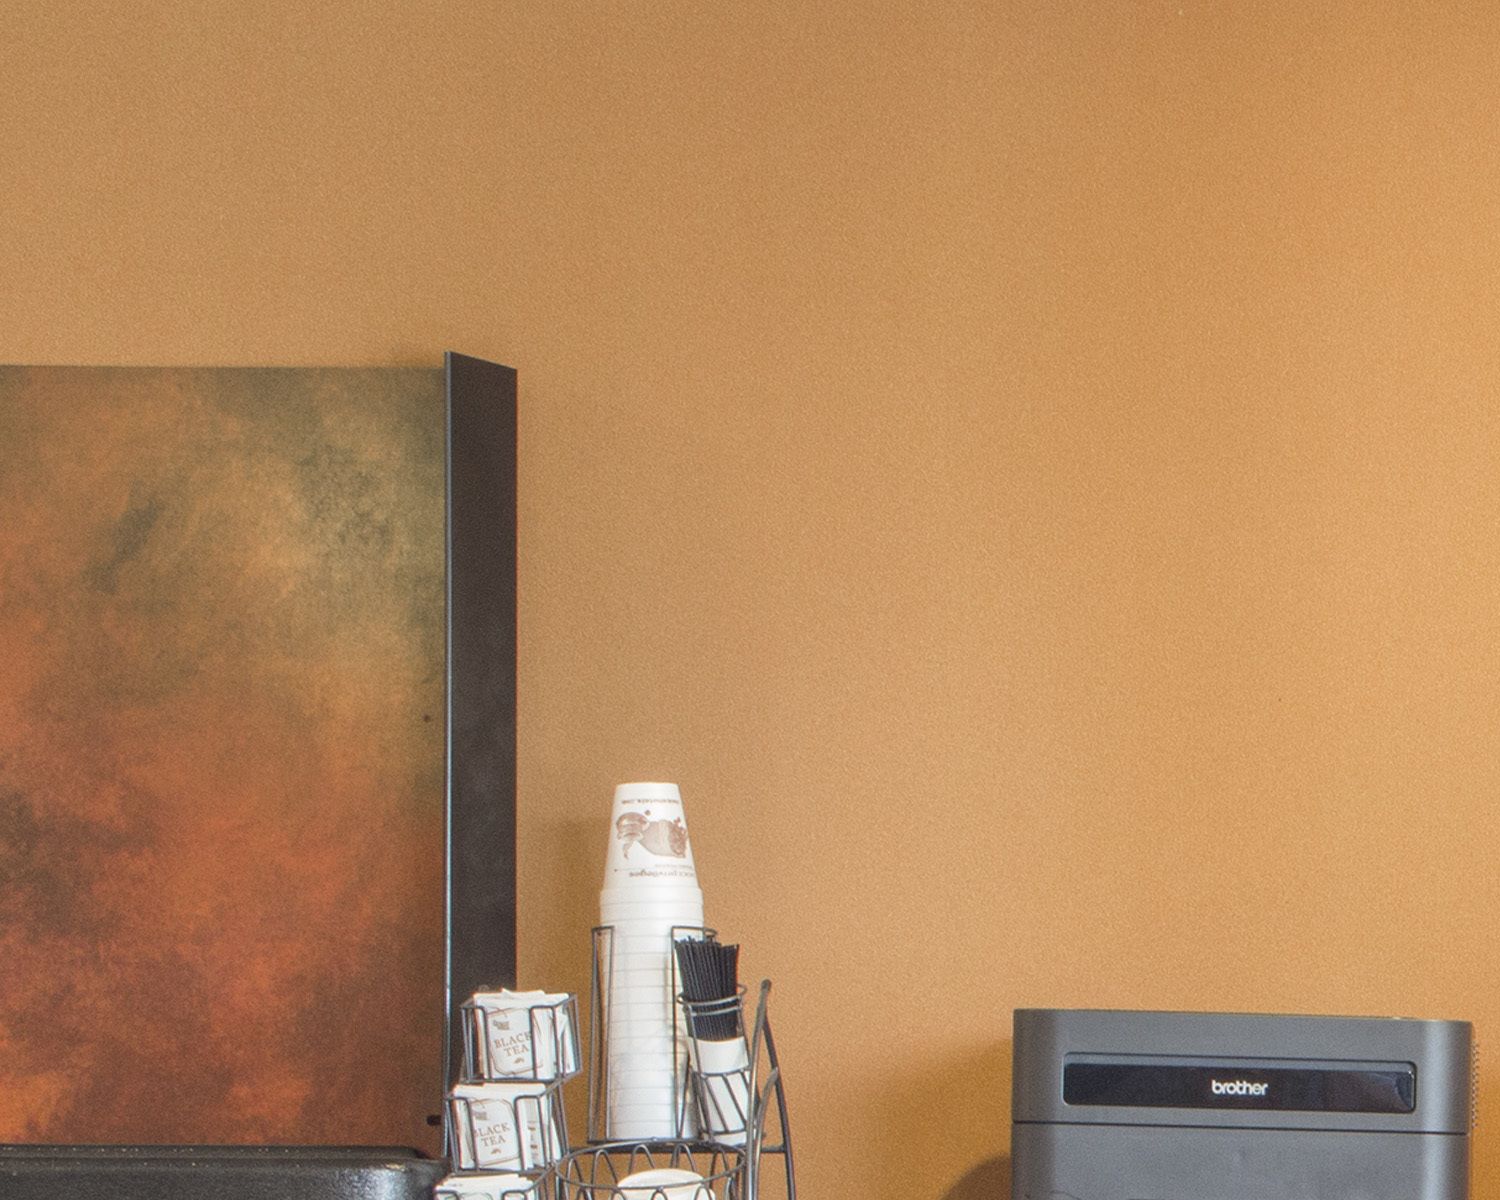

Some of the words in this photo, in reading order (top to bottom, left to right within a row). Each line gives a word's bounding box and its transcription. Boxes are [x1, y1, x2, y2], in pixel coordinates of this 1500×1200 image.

[503, 1044, 529, 1056] TEA
[1211, 1079, 1268, 1096] brother
[481, 1135, 506, 1147] TEA
